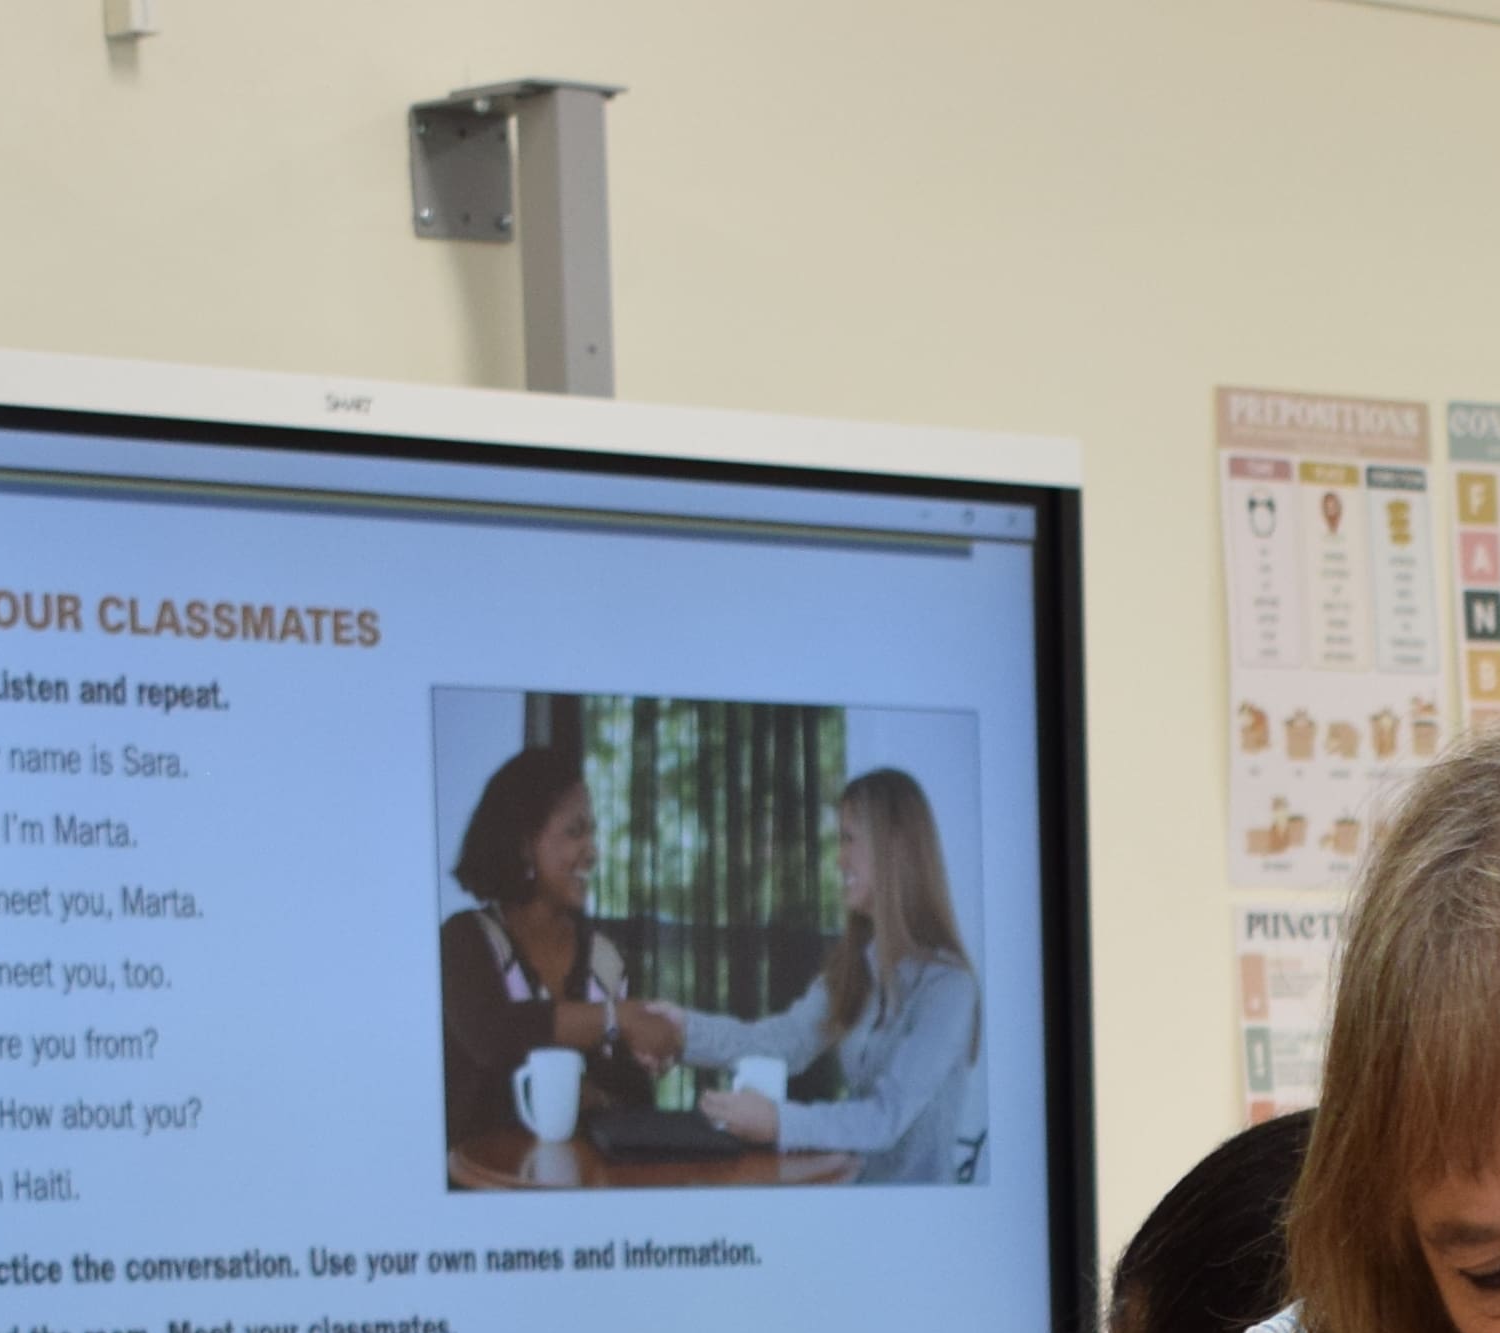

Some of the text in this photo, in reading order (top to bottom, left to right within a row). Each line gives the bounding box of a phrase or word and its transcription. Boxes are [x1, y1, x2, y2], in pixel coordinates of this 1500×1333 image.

[99, 596, 382, 649] CLASSMATES
[1473, 599, 1497, 633] N
[79, 674, 127, 706] and
[137, 679, 231, 714] repeat.
[9, 748, 81, 775] name
[92, 743, 113, 776] is
[123, 745, 189, 780] Sara.
[3, 813, 44, 846] I'm
[54, 814, 138, 849] Marta.
[60, 889, 113, 924] you,
[121, 886, 204, 919] Marta.
[62, 962, 116, 995] you,
[123, 959, 173, 990] too.
[31, 1034, 76, 1068] you
[84, 1027, 159, 1060] from?
[62, 1098, 134, 1130] about
[143, 1097, 203, 1136] you?
[13, 1169, 80, 1201] Haiti.
[73, 1254, 115, 1283] the
[125, 1247, 300, 1284] conversation.
[309, 1247, 357, 1277] Use
[366, 1250, 418, 1283] your
[428, 1249, 477, 1273] own
[486, 1245, 564, 1273] names
[573, 1239, 616, 1270] and
[624, 1237, 762, 1269] information.
